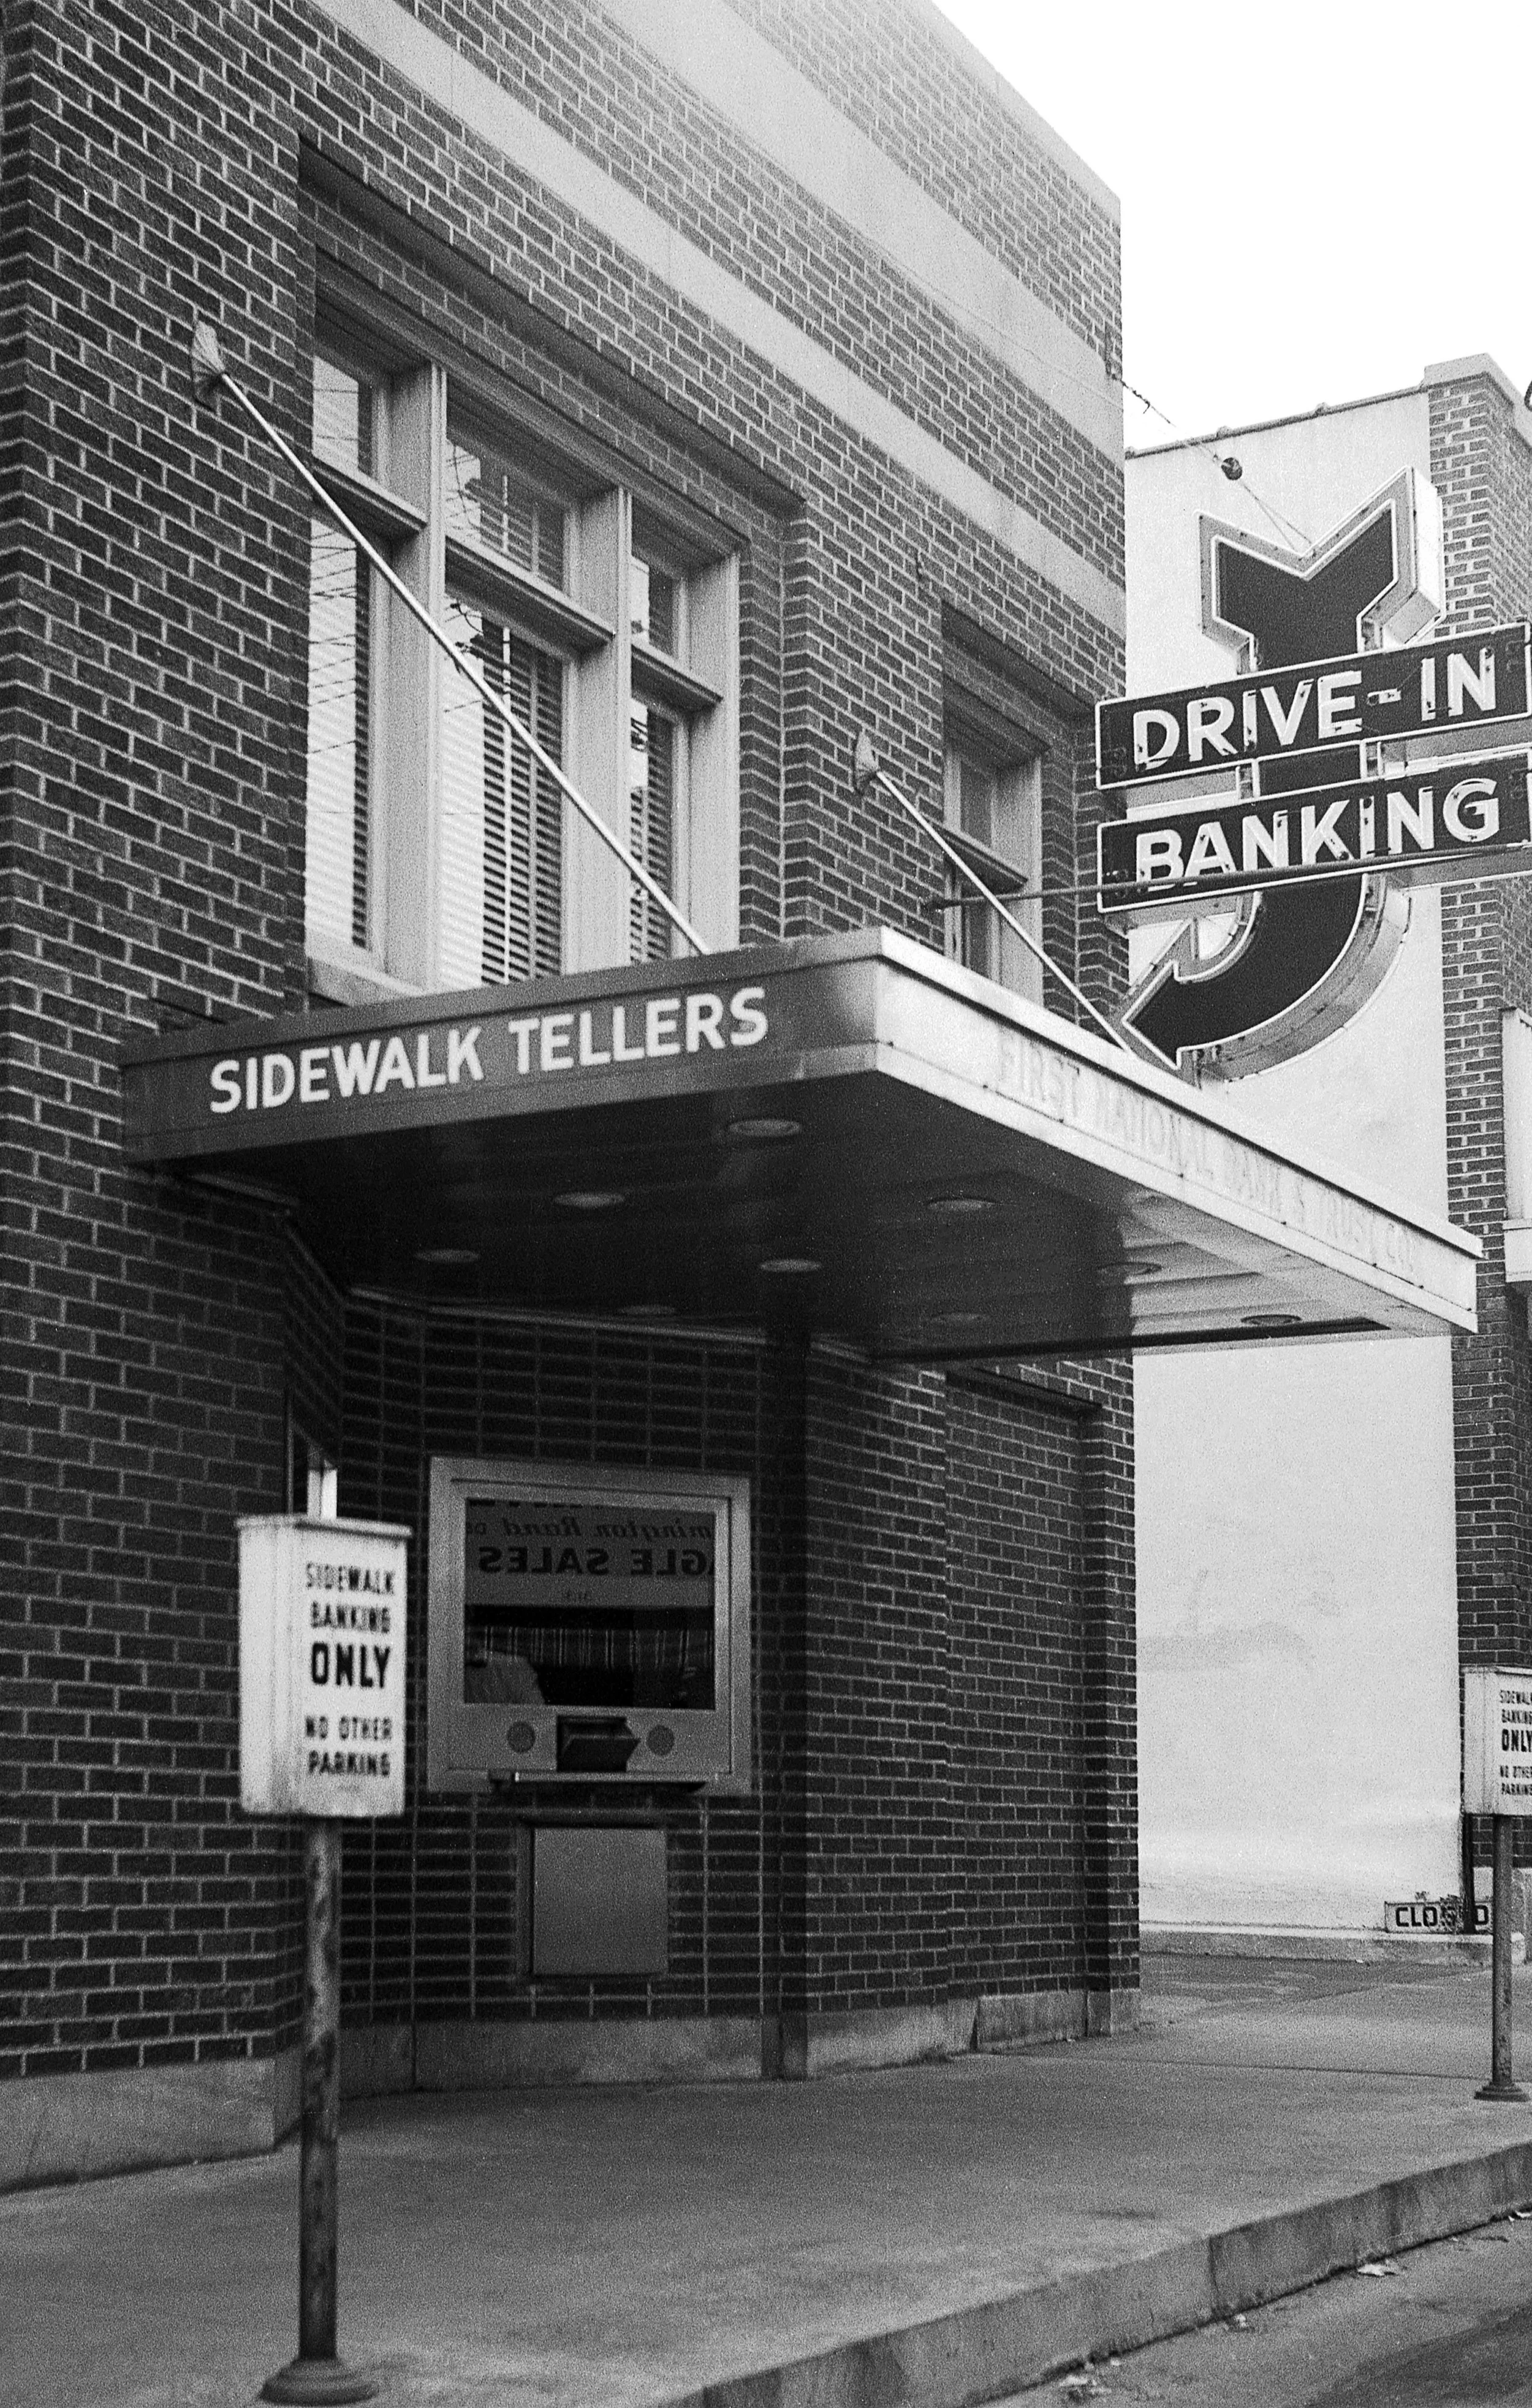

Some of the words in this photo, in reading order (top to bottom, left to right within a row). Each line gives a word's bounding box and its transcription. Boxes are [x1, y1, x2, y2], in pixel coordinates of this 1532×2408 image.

[1136, 778, 1499, 892] BANKING
[210, 1026, 483, 1113] SIDEWALK
[508, 987, 768, 1074] TELLERS
[999, 1031, 1082, 1119] FIRST
[306, 1562, 394, 1594] SIDEWALK
[311, 1601, 390, 1633] BANKING
[311, 1641, 390, 1689] ONLY
[306, 1715, 328, 1739] NO
[339, 1716, 392, 1741] OTHER
[1501, 1728, 1532, 1752] ONLY
[308, 1750, 390, 1777] PARKING
[1395, 1905, 1489, 1928] CLOSD
